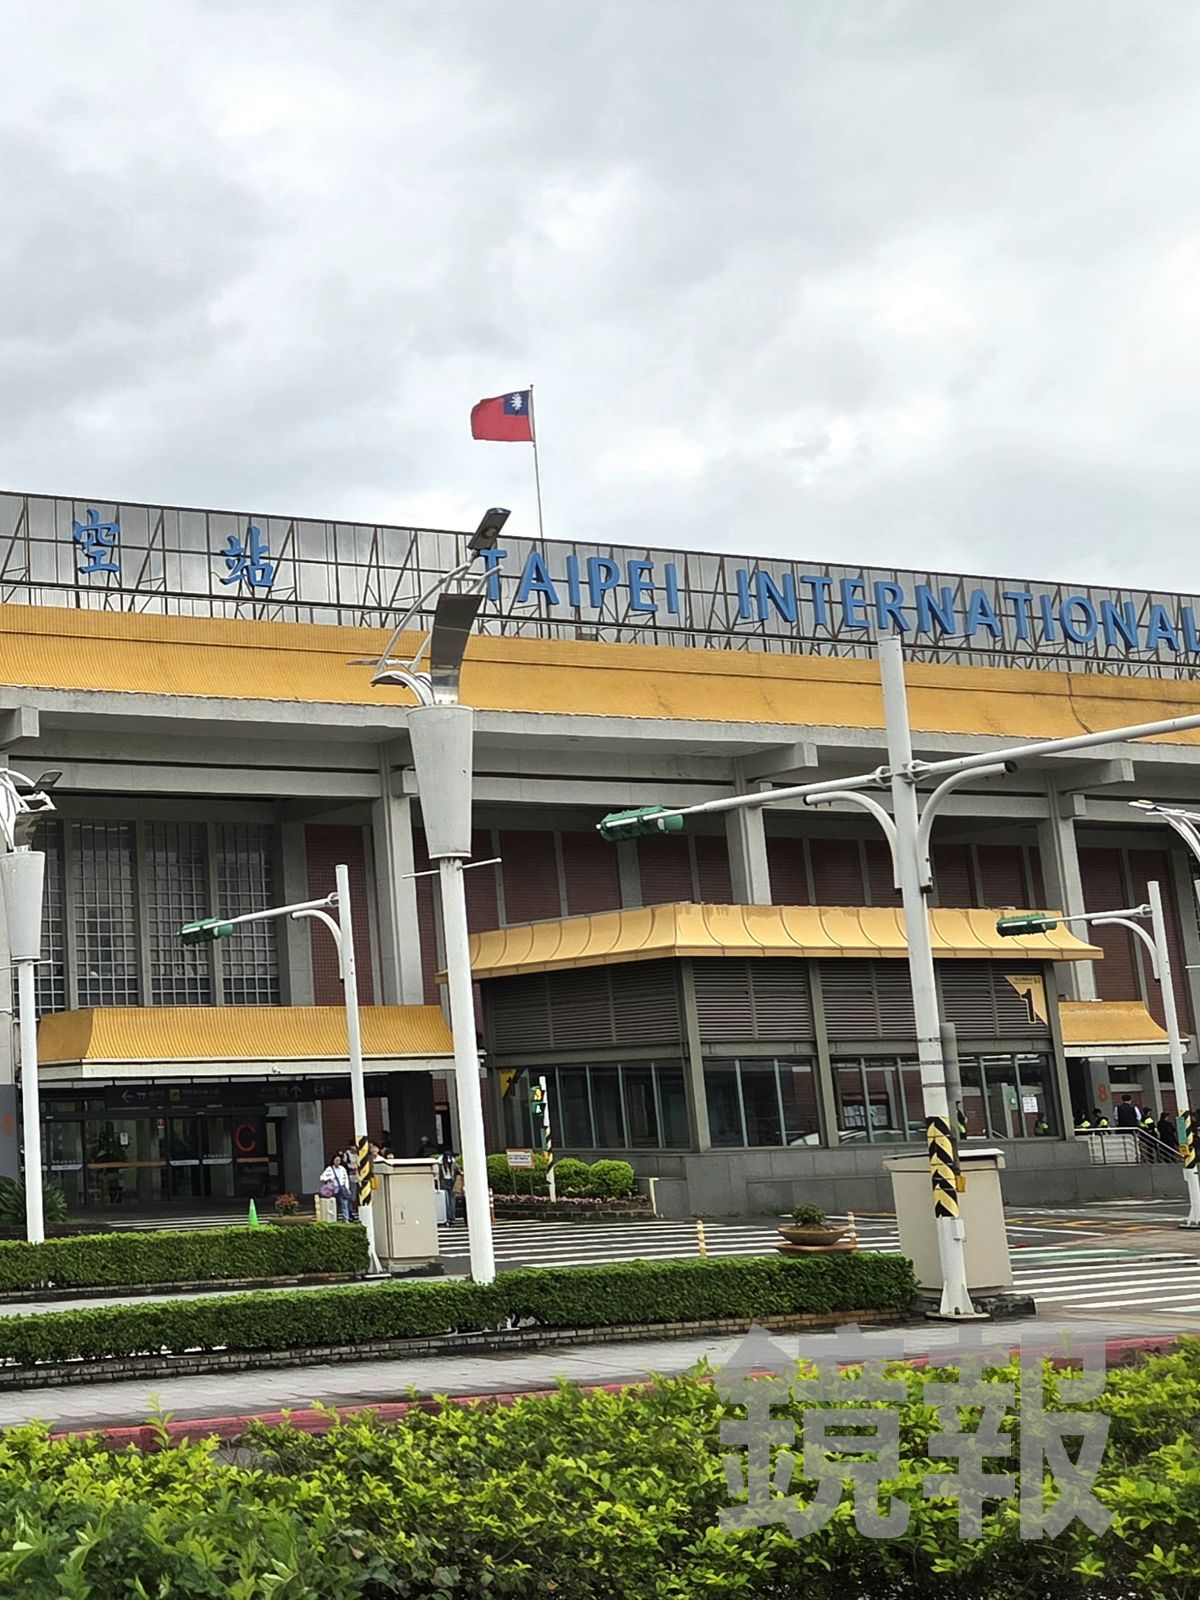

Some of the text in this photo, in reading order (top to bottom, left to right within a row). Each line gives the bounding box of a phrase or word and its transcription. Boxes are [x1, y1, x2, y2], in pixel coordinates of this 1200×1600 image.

[481, 549, 1200, 651] TAIPEI INTERNATIONAL
[1021, 988, 1035, 1022] 1
[1097, 1084, 1108, 1102] 8
[235, 1123, 257, 1152] C
